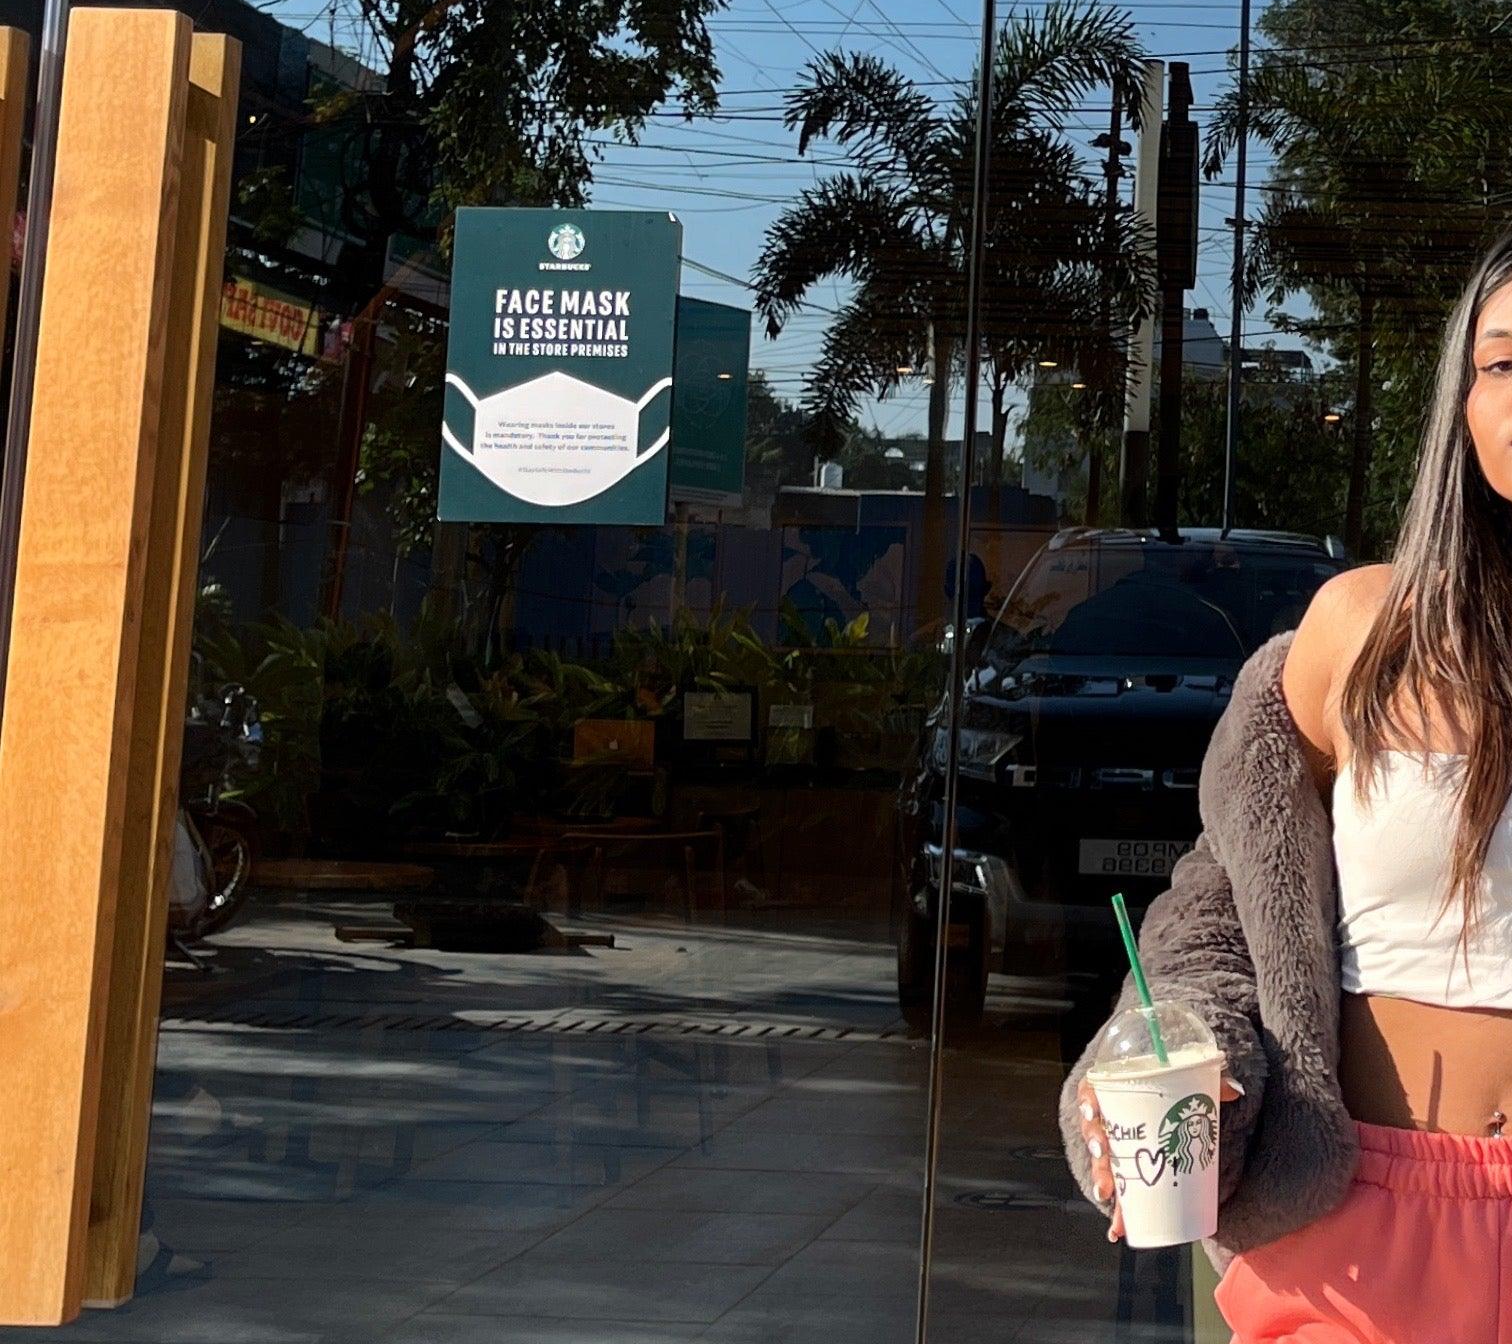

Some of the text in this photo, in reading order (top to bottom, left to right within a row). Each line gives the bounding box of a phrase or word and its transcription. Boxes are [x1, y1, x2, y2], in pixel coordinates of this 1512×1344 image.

[538, 262, 591, 272] STARBUCKS
[494, 289, 631, 316] FACE MASK
[493, 317, 630, 342] IS ESSENTIAL
[493, 342, 628, 358] IN THE STORE PREMISES
